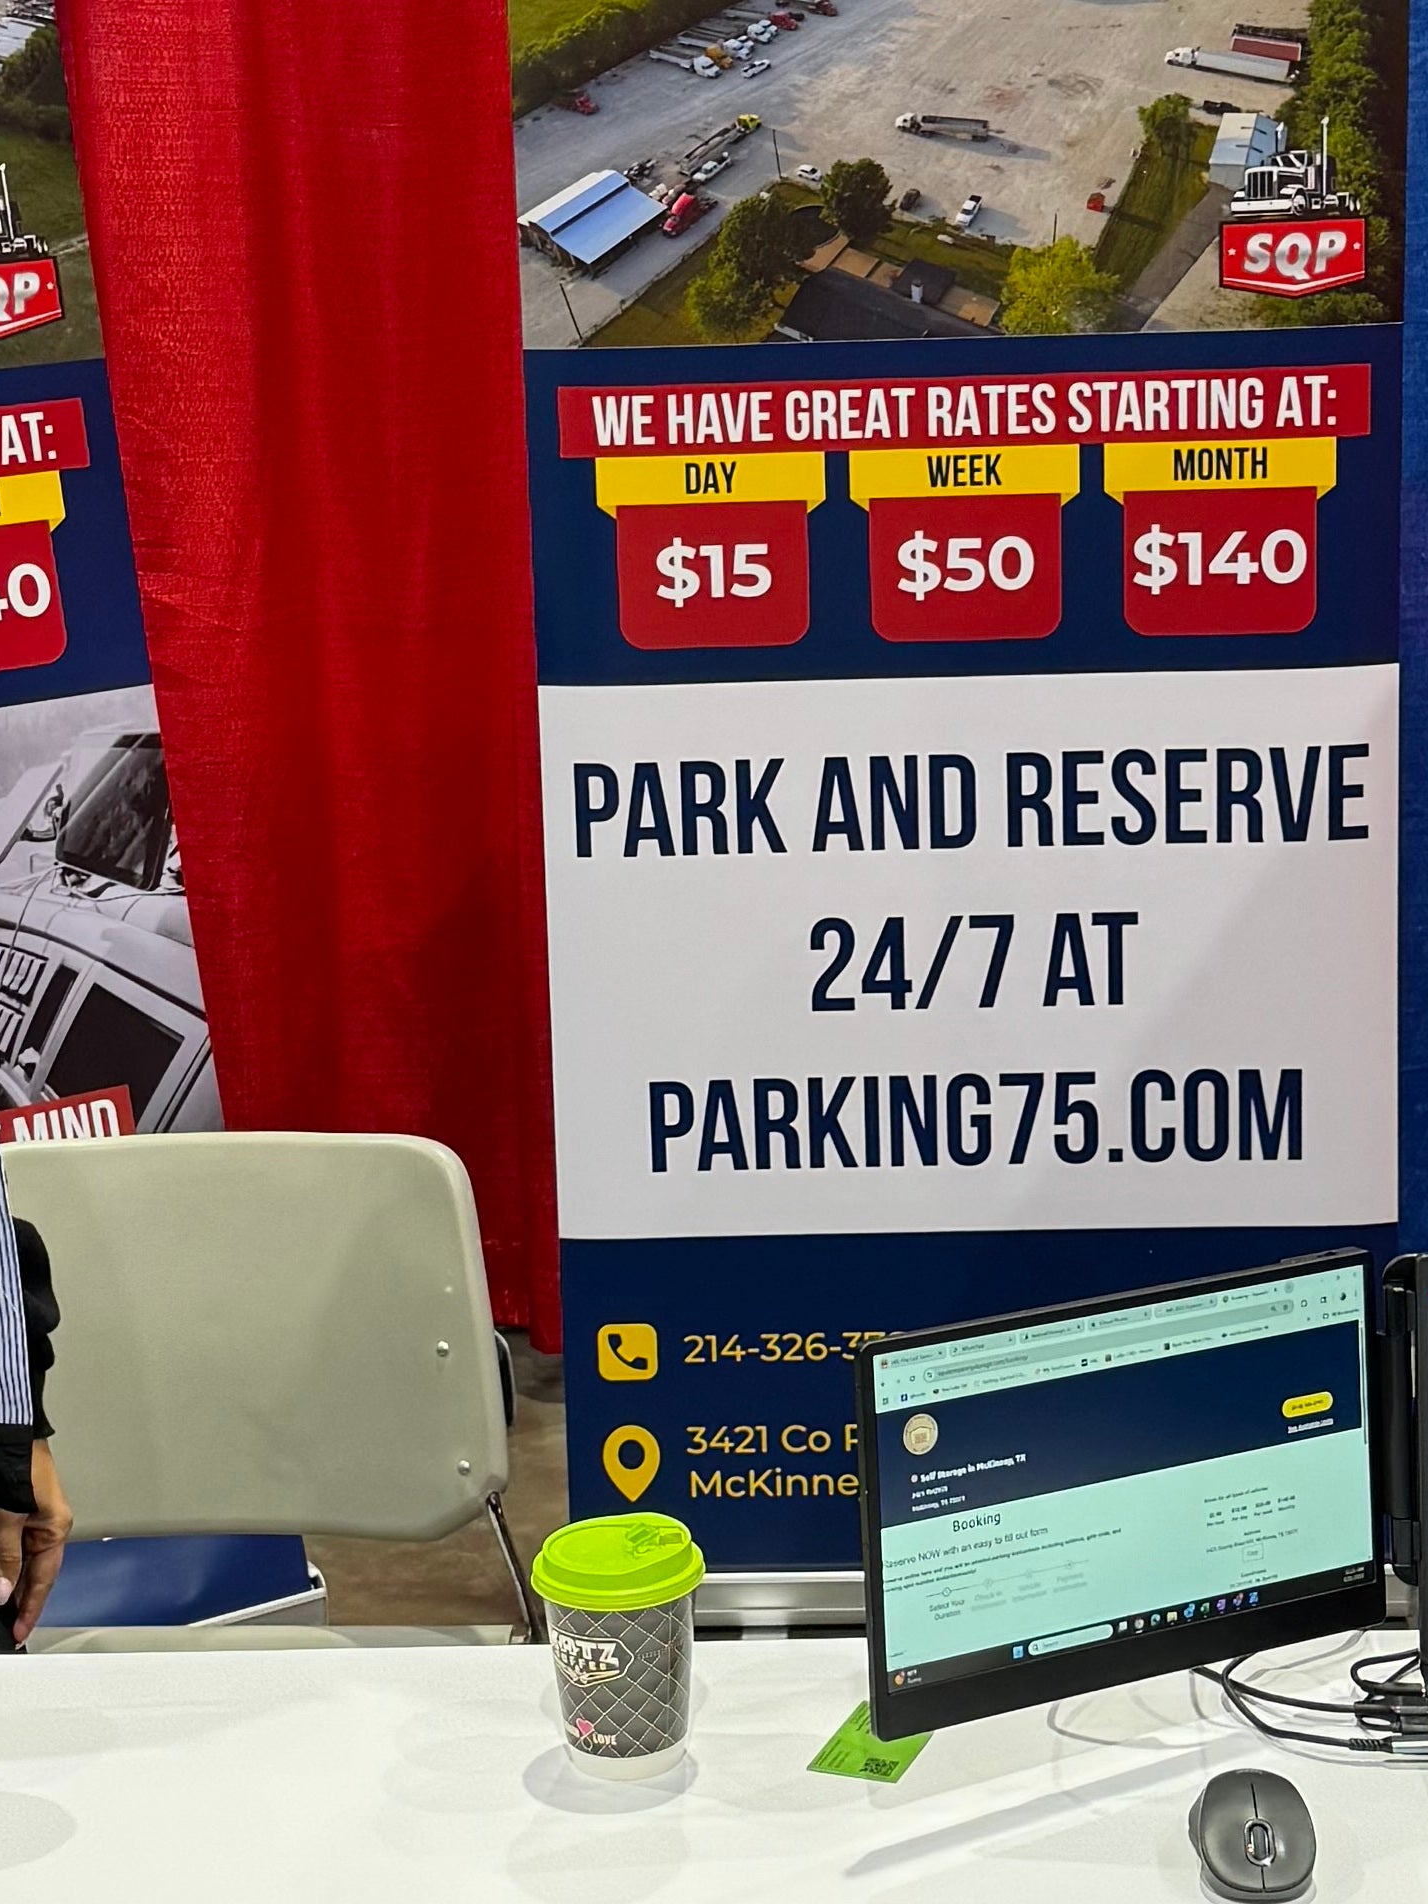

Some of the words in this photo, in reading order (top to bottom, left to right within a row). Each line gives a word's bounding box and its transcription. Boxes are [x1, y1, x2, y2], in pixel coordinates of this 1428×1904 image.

[1245, 231, 1343, 281] SQP
[592, 396, 654, 445] WE
[668, 392, 773, 444] HAVE
[786, 388, 915, 440] GREAT
[928, 384, 1055, 436] RATES
[1069, 378, 1263, 432] STARTING
[1277, 376, 1336, 426] AT:
[2, 412, 56, 465] AT:
[1174, 447, 1267, 480] MONTH
[686, 462, 736, 494] DAY
[928, 454, 1001, 487] WEEK
[655, 537, 772, 608] $15
[897, 530, 1034, 601] $50
[1132, 523, 1307, 595] $140
[574, 758, 787, 857] PARK
[812, 755, 976, 852] AND
[1007, 743, 1369, 847] RESERVE
[811, 914, 1014, 1011] 24/7
[1043, 912, 1138, 1006] AT
[649, 1069, 1302, 1172] PARKING75.COM
[686, 1425, 768, 1455] 3421
[780, 1424, 831, 1453] Co
[952, 1512, 1002, 1534] Booking
[918, 1548, 941, 1562] NOW
[592, 1732, 618, 1746] LOVE
